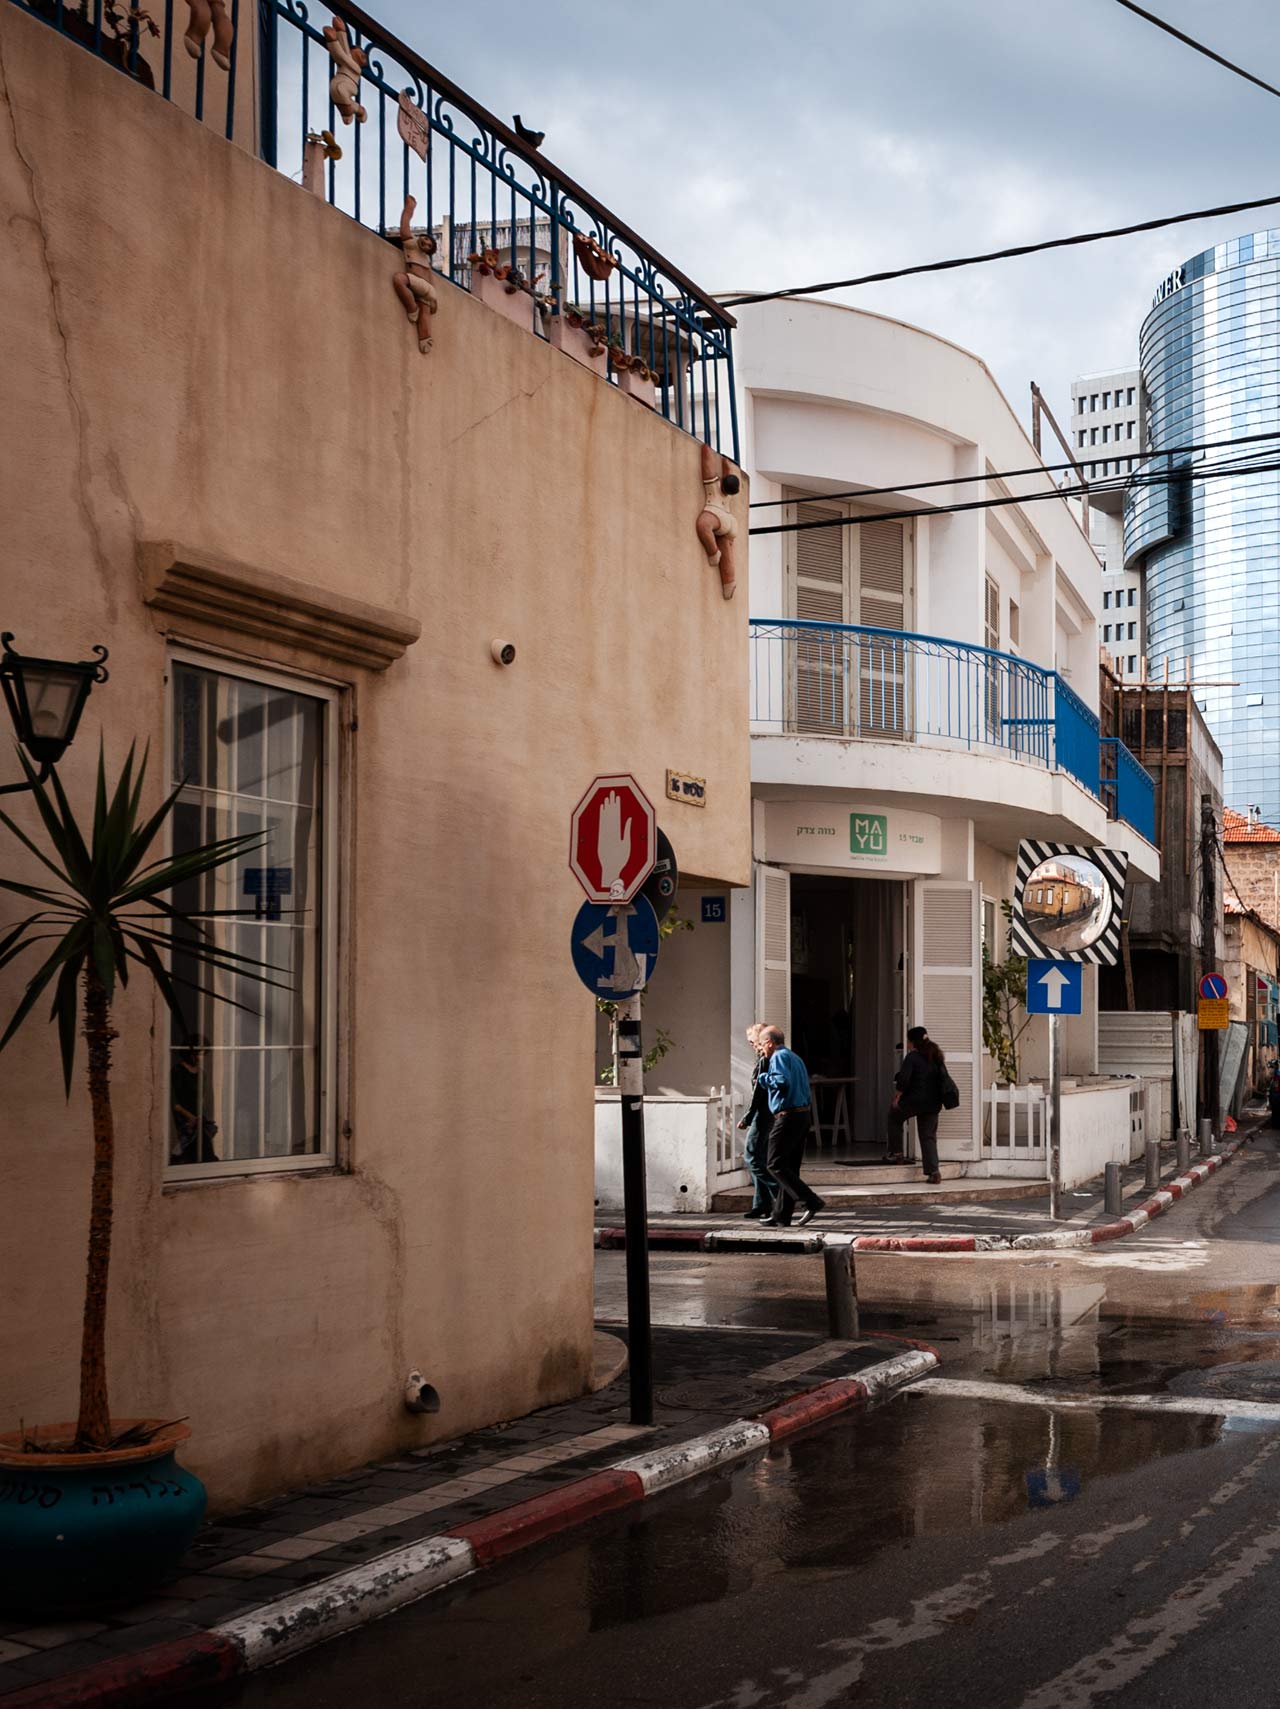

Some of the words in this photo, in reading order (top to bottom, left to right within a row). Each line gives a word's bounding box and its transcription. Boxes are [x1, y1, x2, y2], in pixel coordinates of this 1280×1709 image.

[796, 826, 815, 836] צדק
[817, 827, 836, 836] נווה
[705, 903, 721, 918] 15
